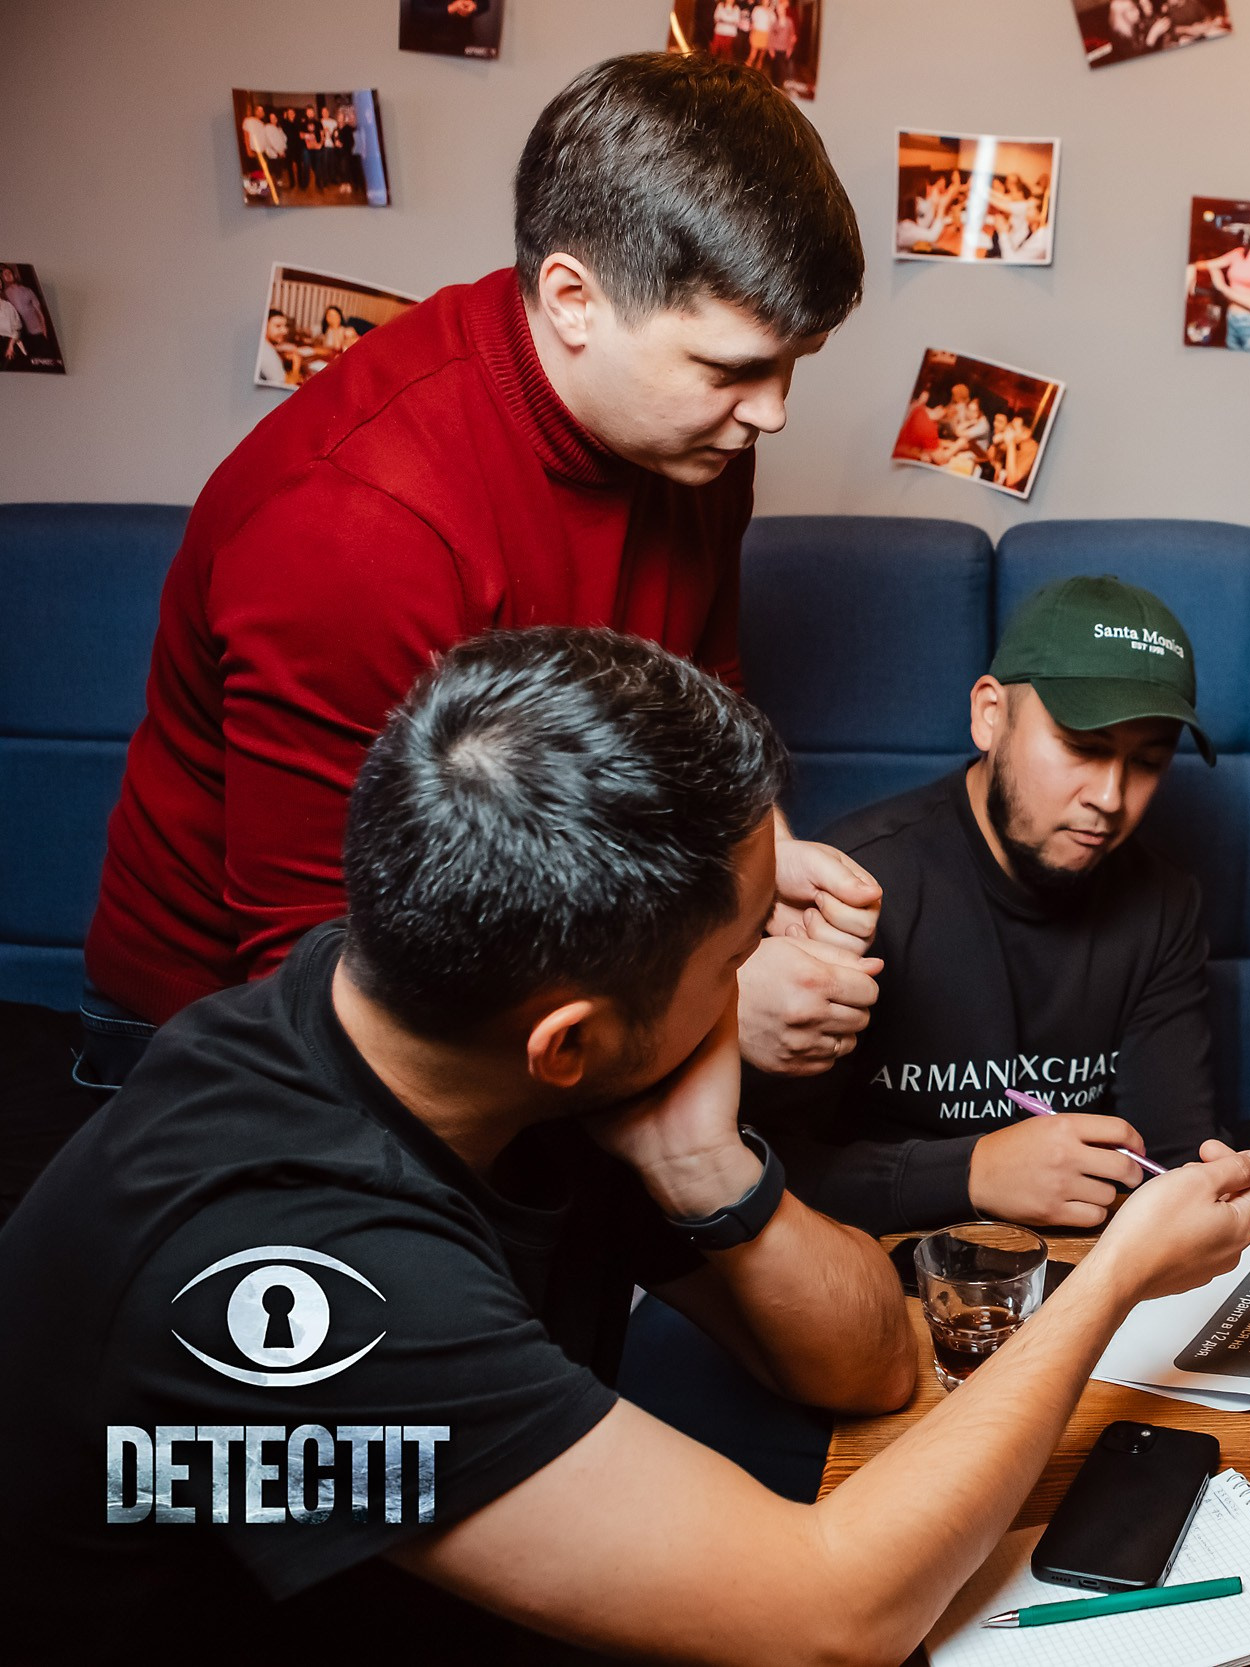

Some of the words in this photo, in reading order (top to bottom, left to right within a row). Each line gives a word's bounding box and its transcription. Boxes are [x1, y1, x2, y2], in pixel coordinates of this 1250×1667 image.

[1094, 623, 1139, 640] Santa
[1142, 628, 1184, 659] Monica
[1131, 641, 1148, 650] EST
[1221, 1322, 1234, 1330] в
[1210, 1331, 1230, 1341] 12
[1194, 1340, 1217, 1358] дня.
[1227, 1339, 1244, 1350] на
